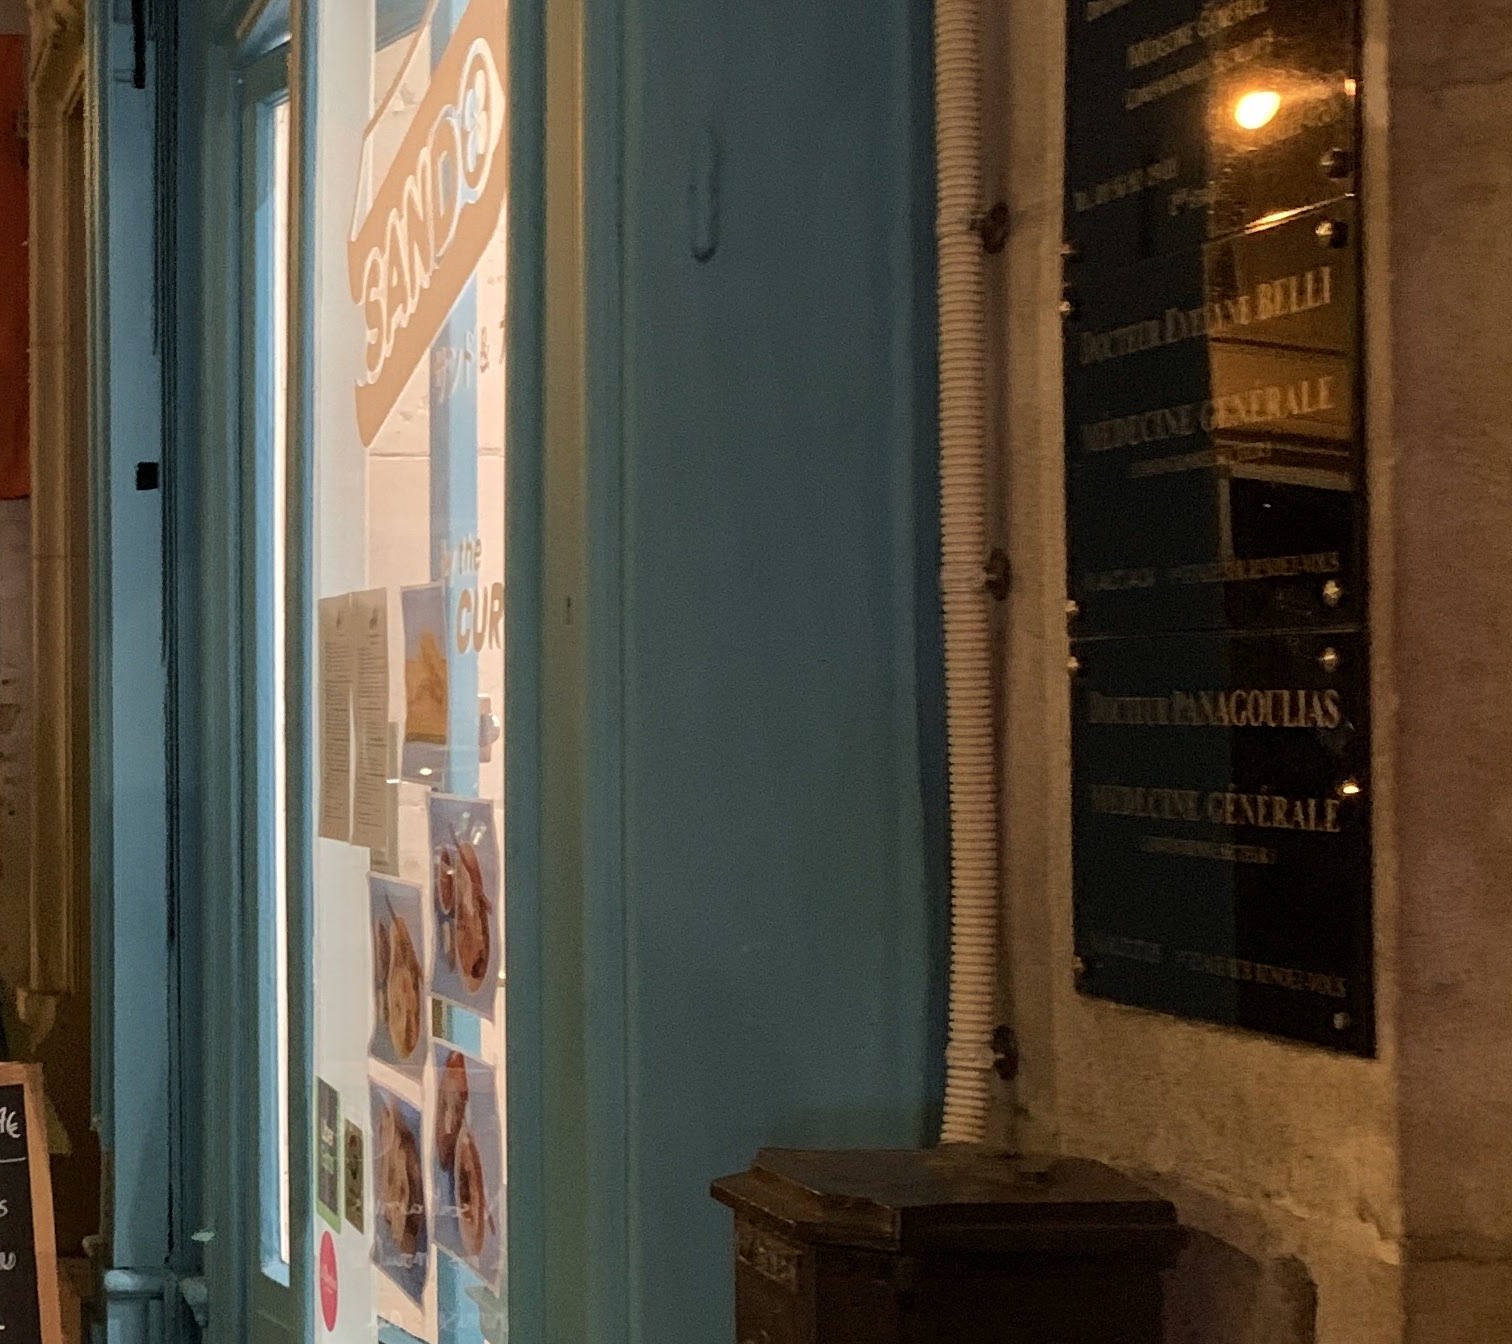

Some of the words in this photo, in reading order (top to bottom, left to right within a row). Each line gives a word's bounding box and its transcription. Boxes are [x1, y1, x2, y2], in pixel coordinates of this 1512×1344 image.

[360, 38, 495, 384] SANDO
[458, 536, 483, 573] the
[1170, 687, 1341, 729] PANAGOULIAS
[1207, 781, 1342, 834] GÉNÉRALE
